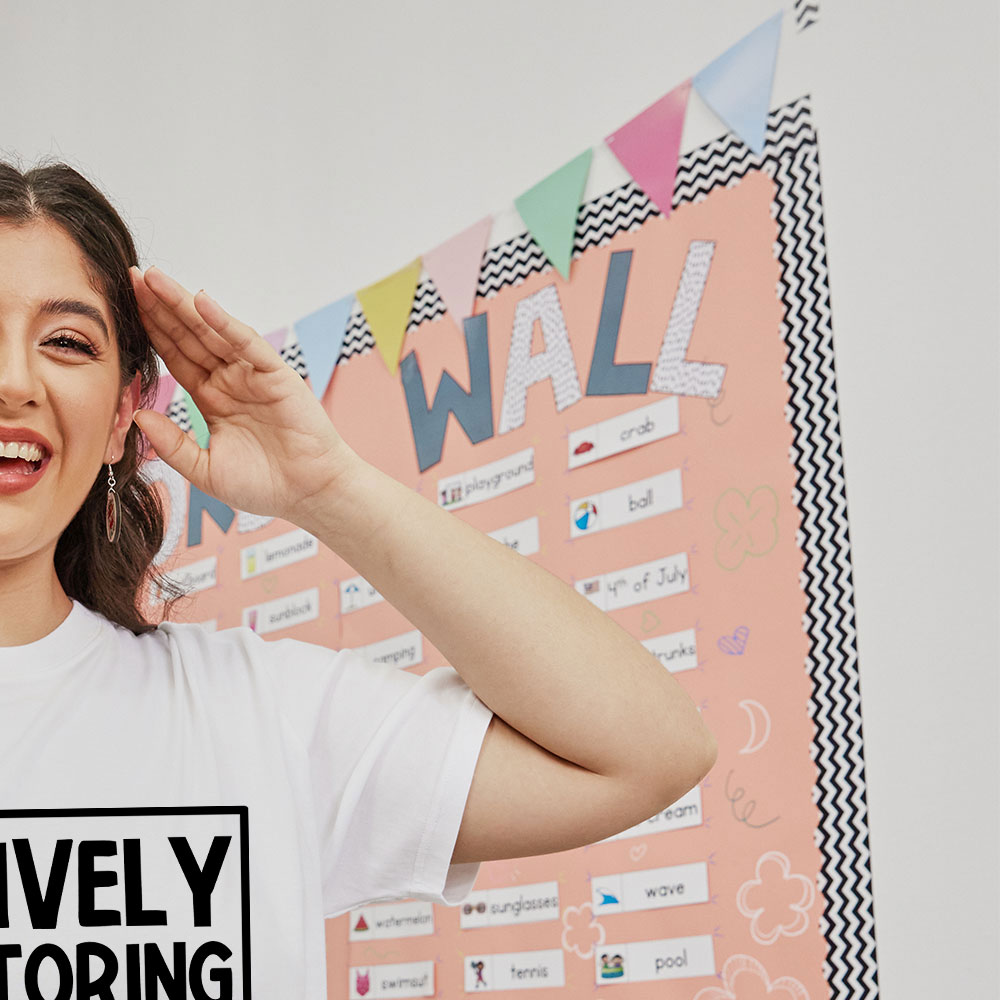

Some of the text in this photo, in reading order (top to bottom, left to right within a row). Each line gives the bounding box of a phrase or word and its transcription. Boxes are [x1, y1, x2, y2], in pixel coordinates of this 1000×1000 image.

[399, 239, 728, 474] WALL
[620, 416, 655, 442] crab
[628, 489, 654, 513] ball
[633, 571, 650, 592] of
[657, 564, 688, 586] July
[645, 883, 685, 899] wave
[490, 895, 559, 917] sunglasses
[510, 963, 550, 980] tennis
[655, 947, 688, 974] pool
